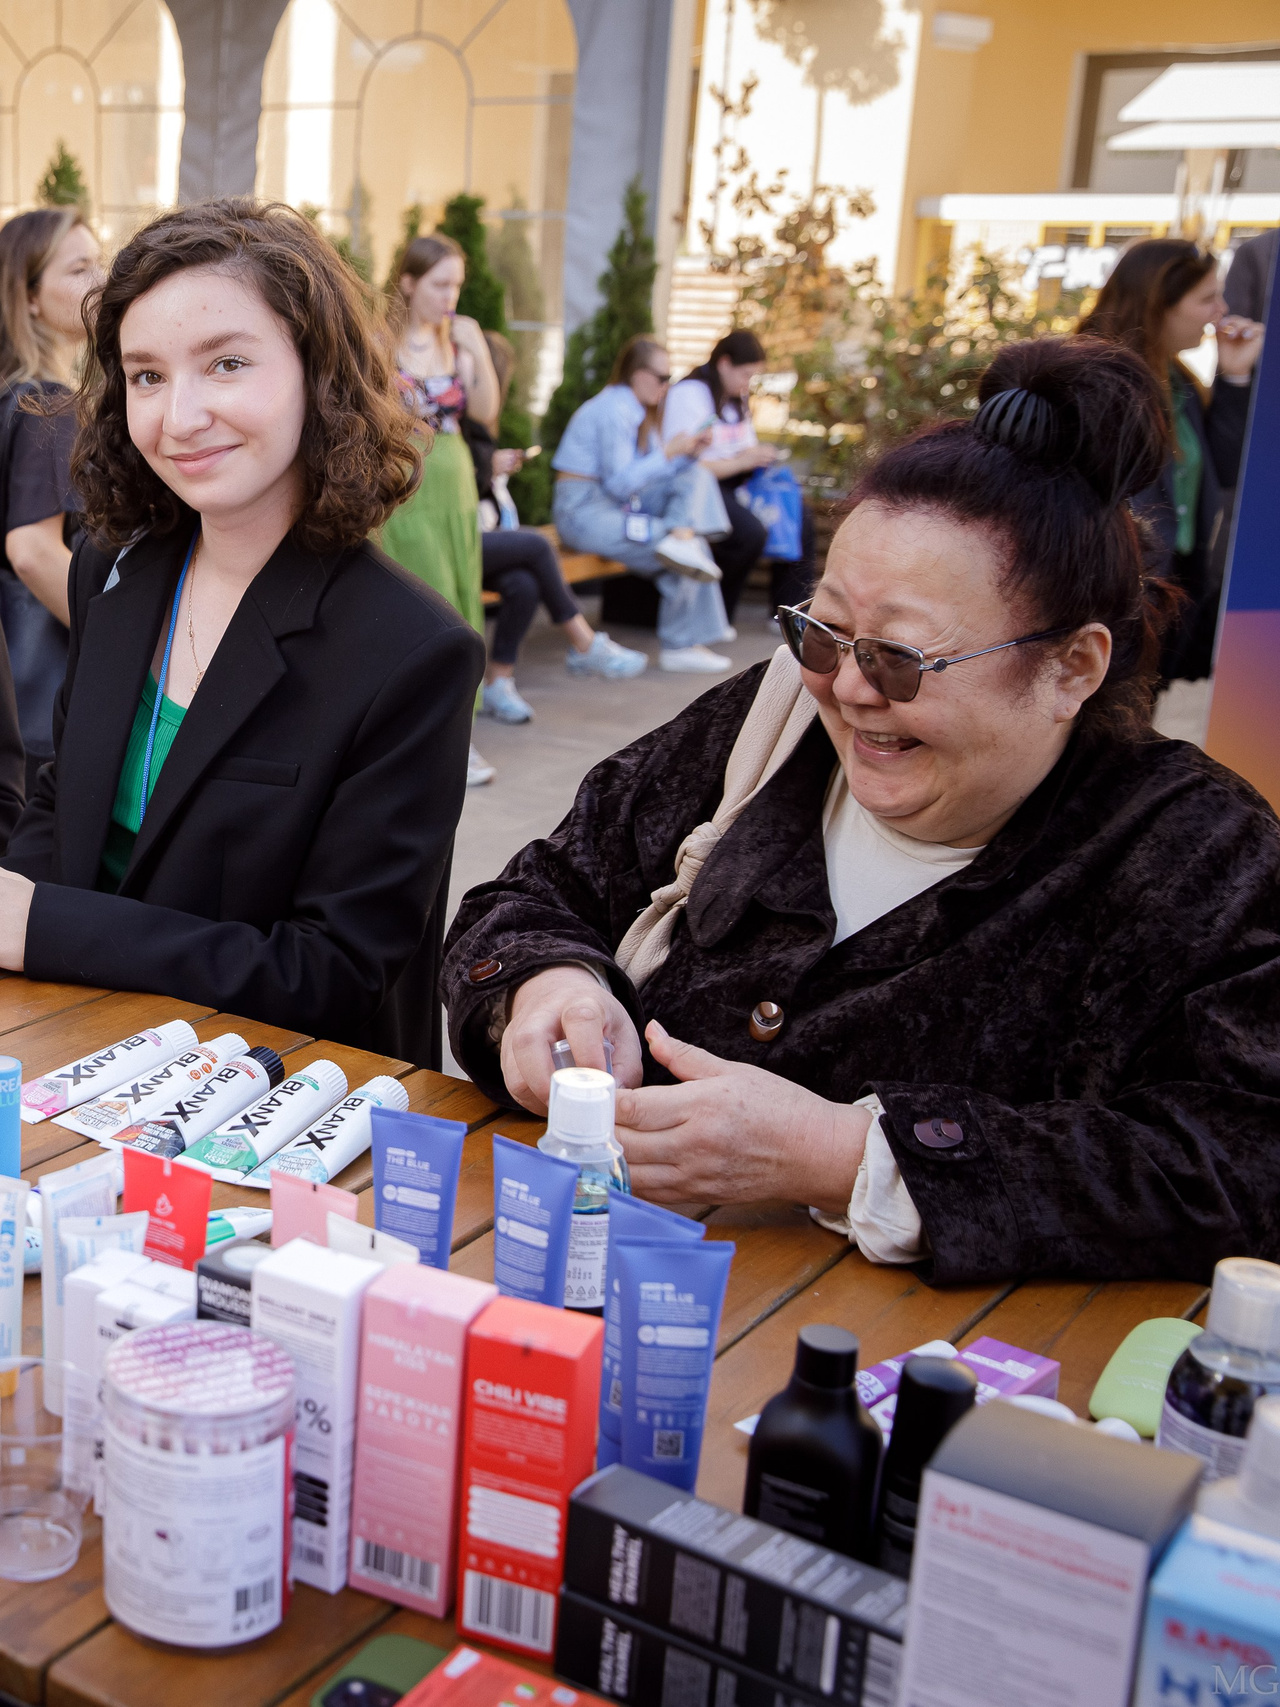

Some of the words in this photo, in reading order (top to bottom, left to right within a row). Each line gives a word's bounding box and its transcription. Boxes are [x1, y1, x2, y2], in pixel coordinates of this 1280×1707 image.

[54, 1034, 148, 1086] BLANX
[114, 1052, 201, 1105] BLANX
[161, 1067, 240, 1123] BLANX
[227, 1080, 305, 1137] BLANX
[293, 1097, 365, 1151] BLANX
[203, 1152, 229, 1165] FRESH
[210, 1148, 234, 1159] WHITE
[386, 1154, 405, 1166] THE
[405, 1156, 430, 1171] BLUE
[517, 1190, 541, 1207] BLUE
[198, 1274, 251, 1301] DIAMON
[201, 1288, 251, 1317] MOUSS
[472, 1377, 522, 1401] CHILI
[522, 1390, 567, 1415] VIBE
